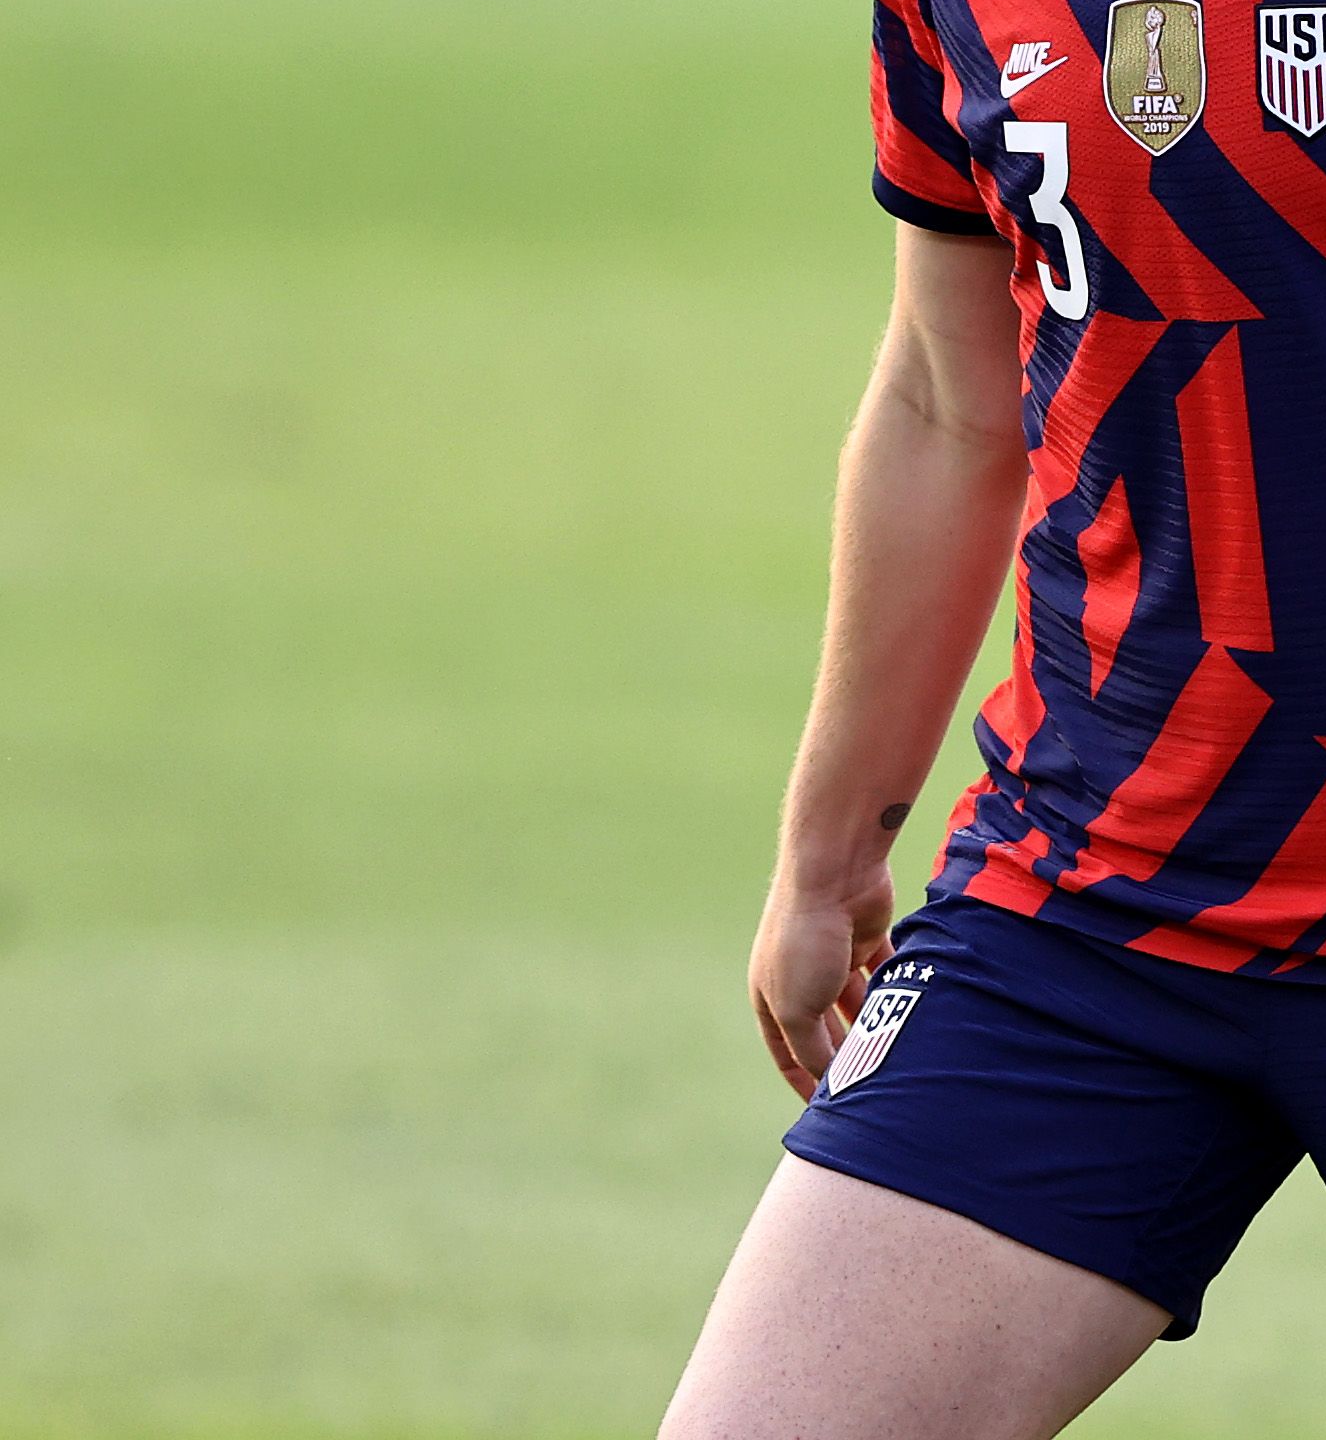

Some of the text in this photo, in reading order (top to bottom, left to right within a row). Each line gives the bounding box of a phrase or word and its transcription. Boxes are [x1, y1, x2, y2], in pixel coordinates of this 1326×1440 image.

[1006, 41, 1052, 74] NIKE
[1132, 95, 1178, 114] FIFA
[1123, 114, 1189, 122] WORLD CHAMPIONS
[1143, 122, 1171, 133] 2019
[1003, 121, 1088, 320] 3
[860, 994, 912, 1031] USA
